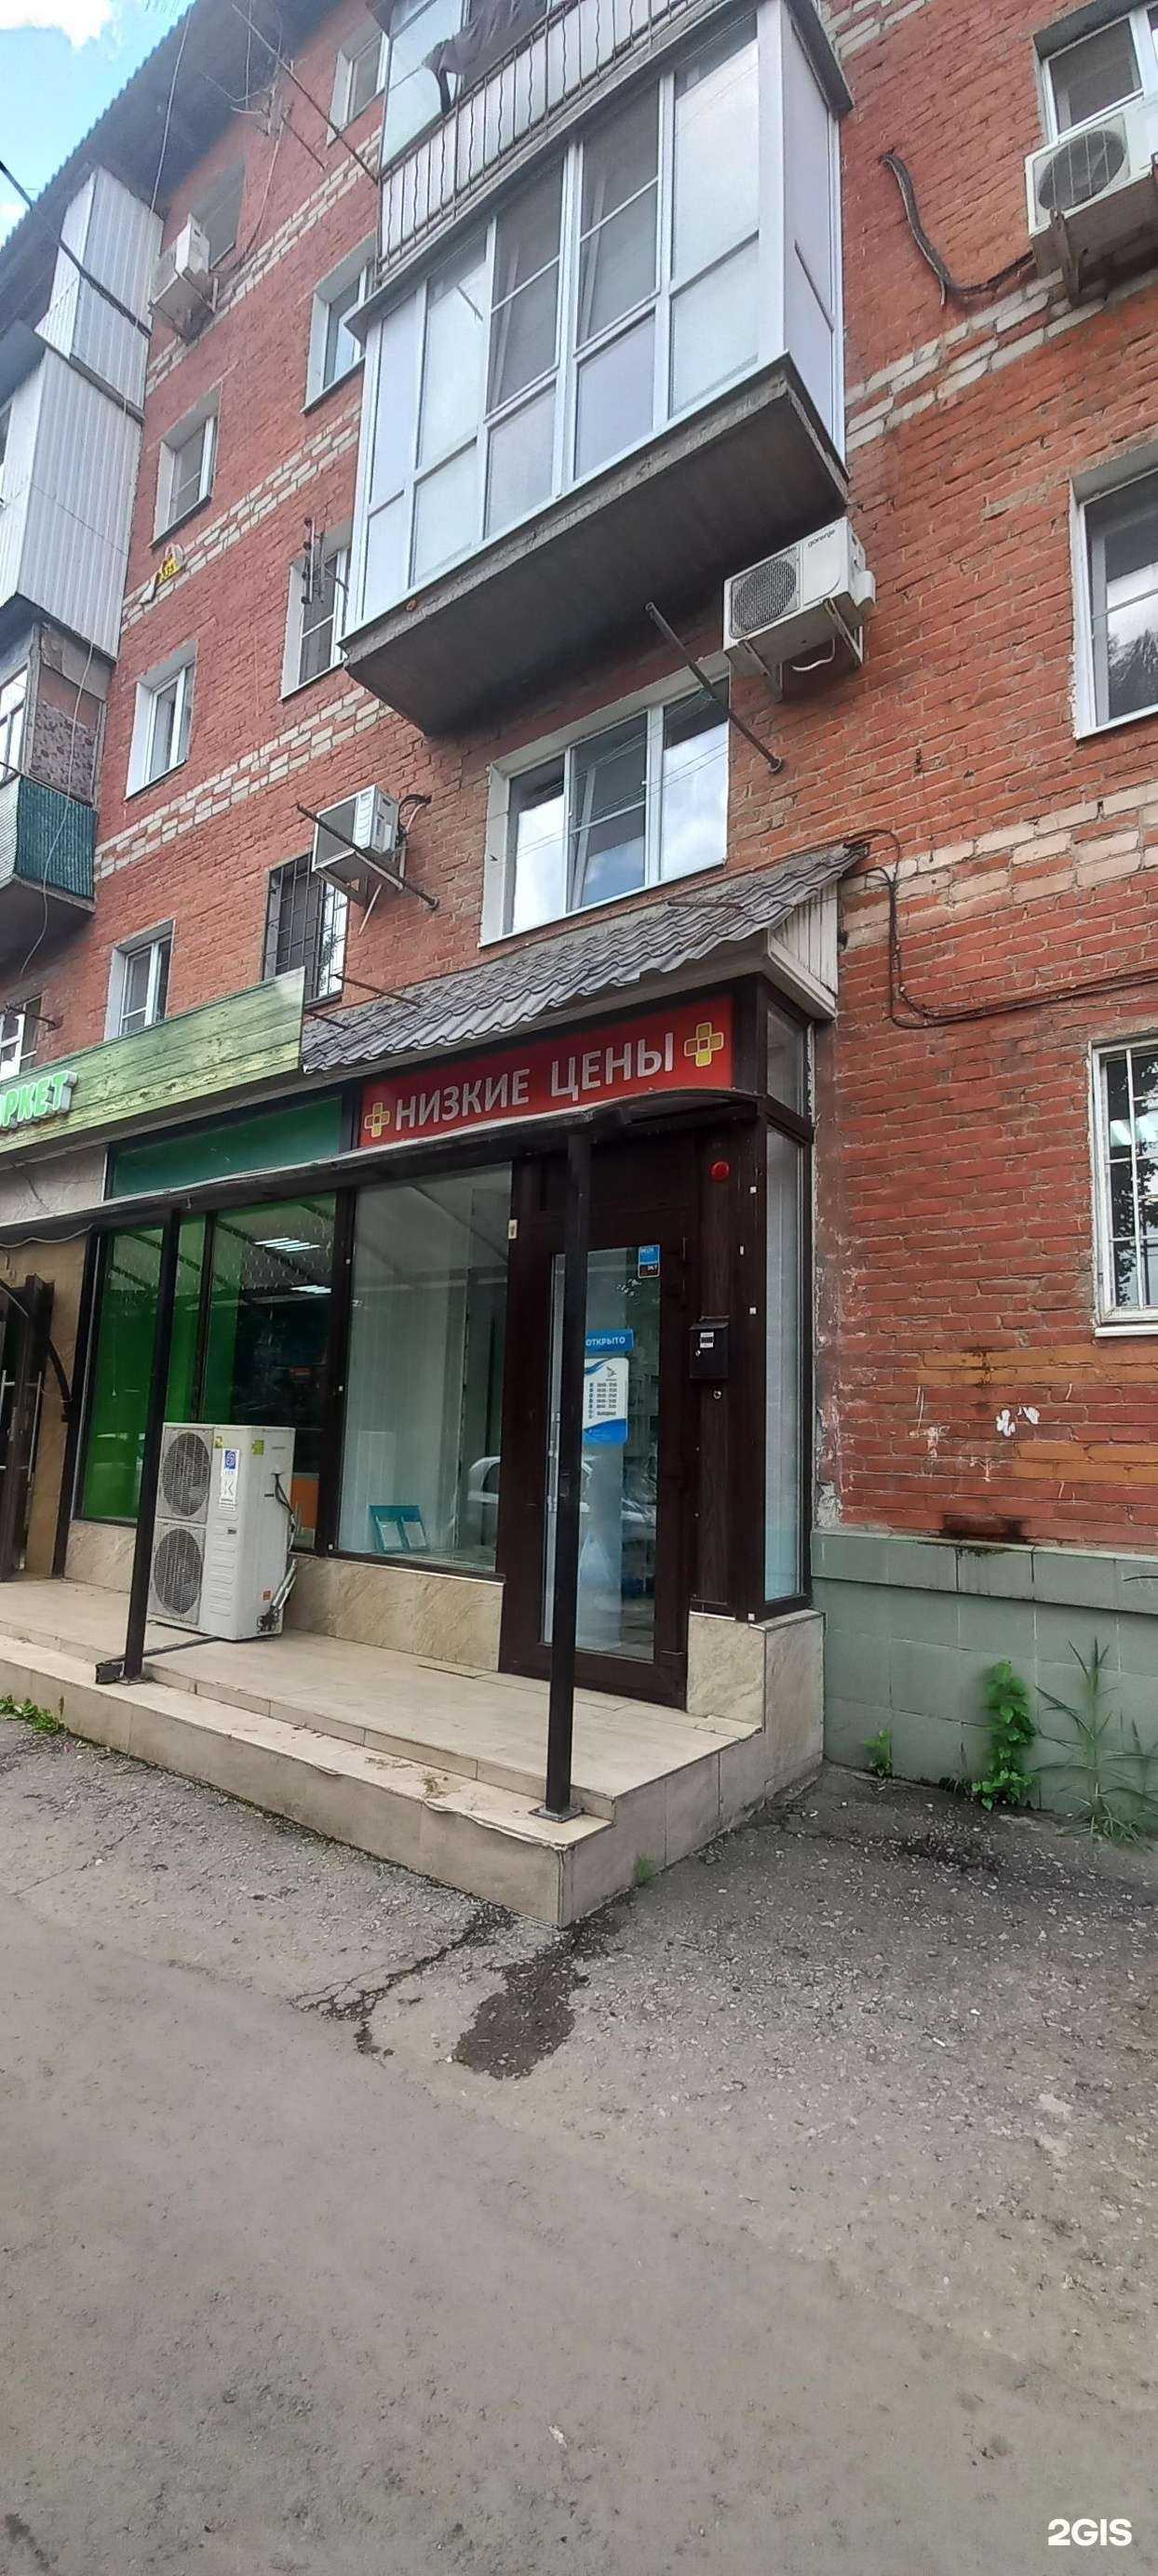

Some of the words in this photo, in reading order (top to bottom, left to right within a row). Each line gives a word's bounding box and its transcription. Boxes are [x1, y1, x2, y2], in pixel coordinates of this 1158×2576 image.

[0, 1070, 74, 1127] РКЕТ
[395, 1068, 531, 1132] НИЗКИЕ
[551, 1032, 675, 1102] ЦЕНЫ
[586, 1336, 626, 1347] ОТКРЫТО
